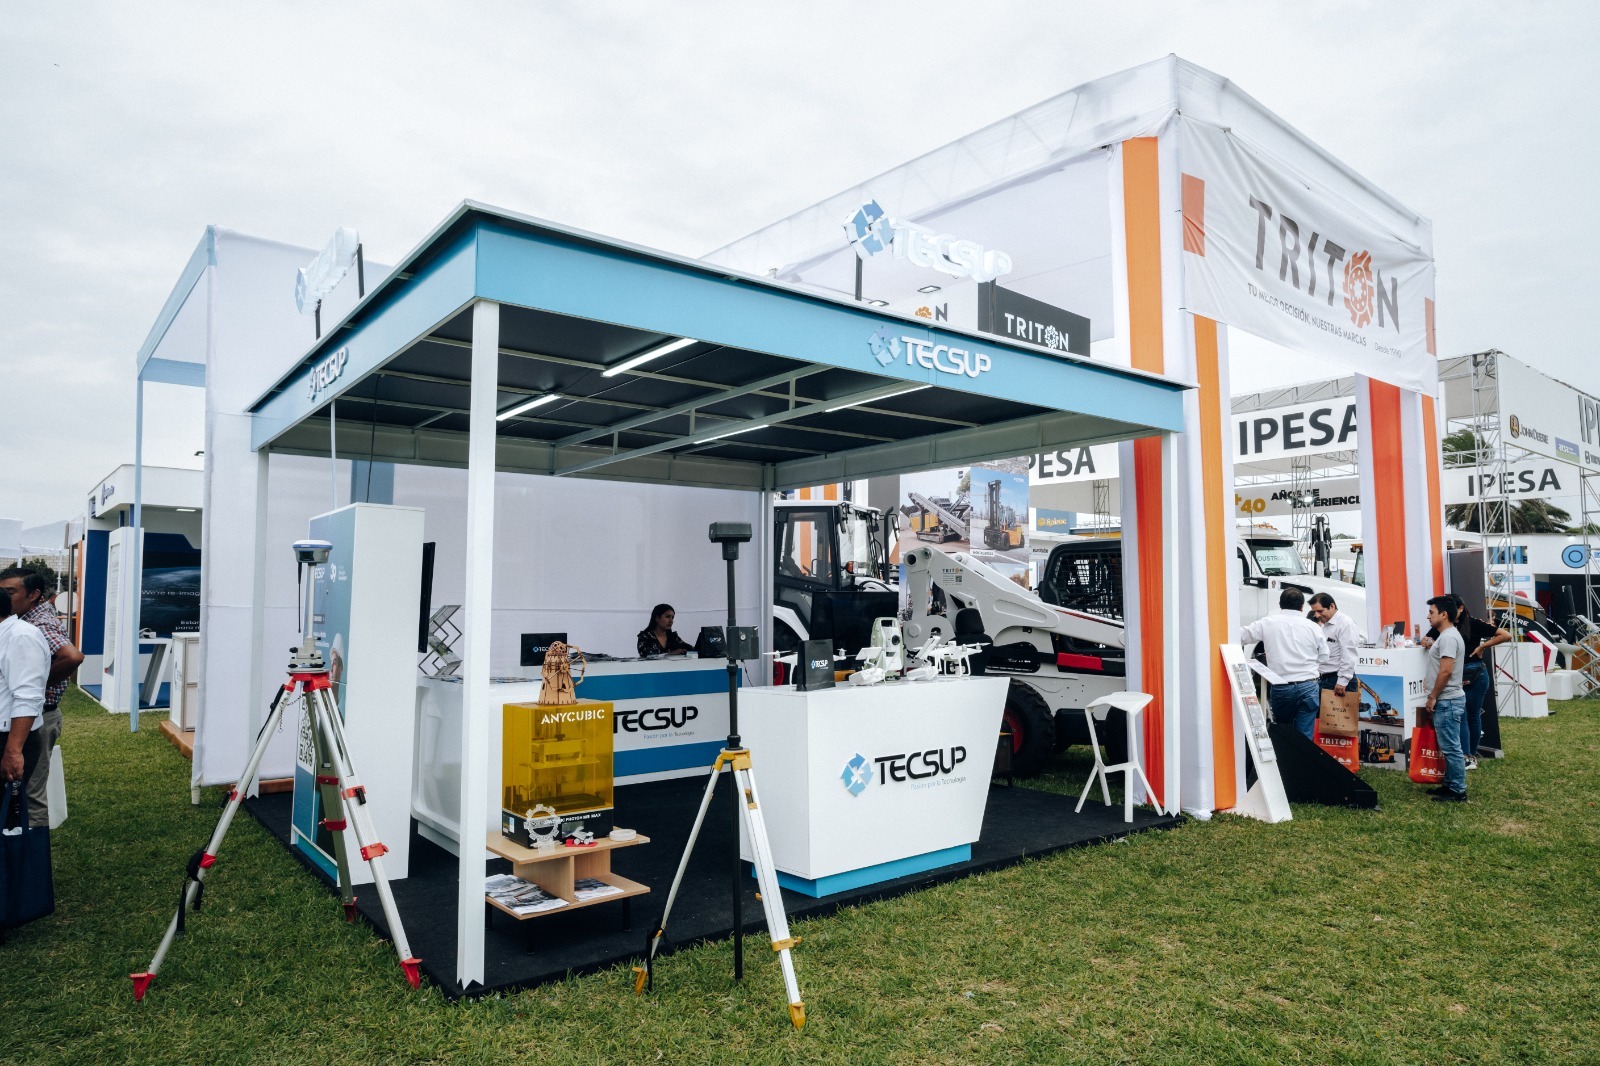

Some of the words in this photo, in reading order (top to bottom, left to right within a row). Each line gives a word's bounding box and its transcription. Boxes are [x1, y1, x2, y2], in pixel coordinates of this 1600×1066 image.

[893, 218, 1012, 283] TECSUP
[1249, 193, 1400, 334] TRITON
[1004, 312, 1069, 351] TRITON
[1247, 282, 1258, 297] TU
[1311, 316, 1343, 338] NUESTRAS
[1343, 328, 1367, 347] MARCAS
[315, 347, 349, 393] TECSUP
[901, 335, 992, 378] TECSUP
[1578, 394, 1600, 448] IP
[1468, 468, 1561, 497] IPESA
[1359, 657, 1389, 666] RITON
[541, 709, 605, 725] ANYCUBIC
[613, 706, 698, 733] TECSUP
[1320, 738, 1353, 746] TRITON
[874, 745, 967, 785] TECSUP
